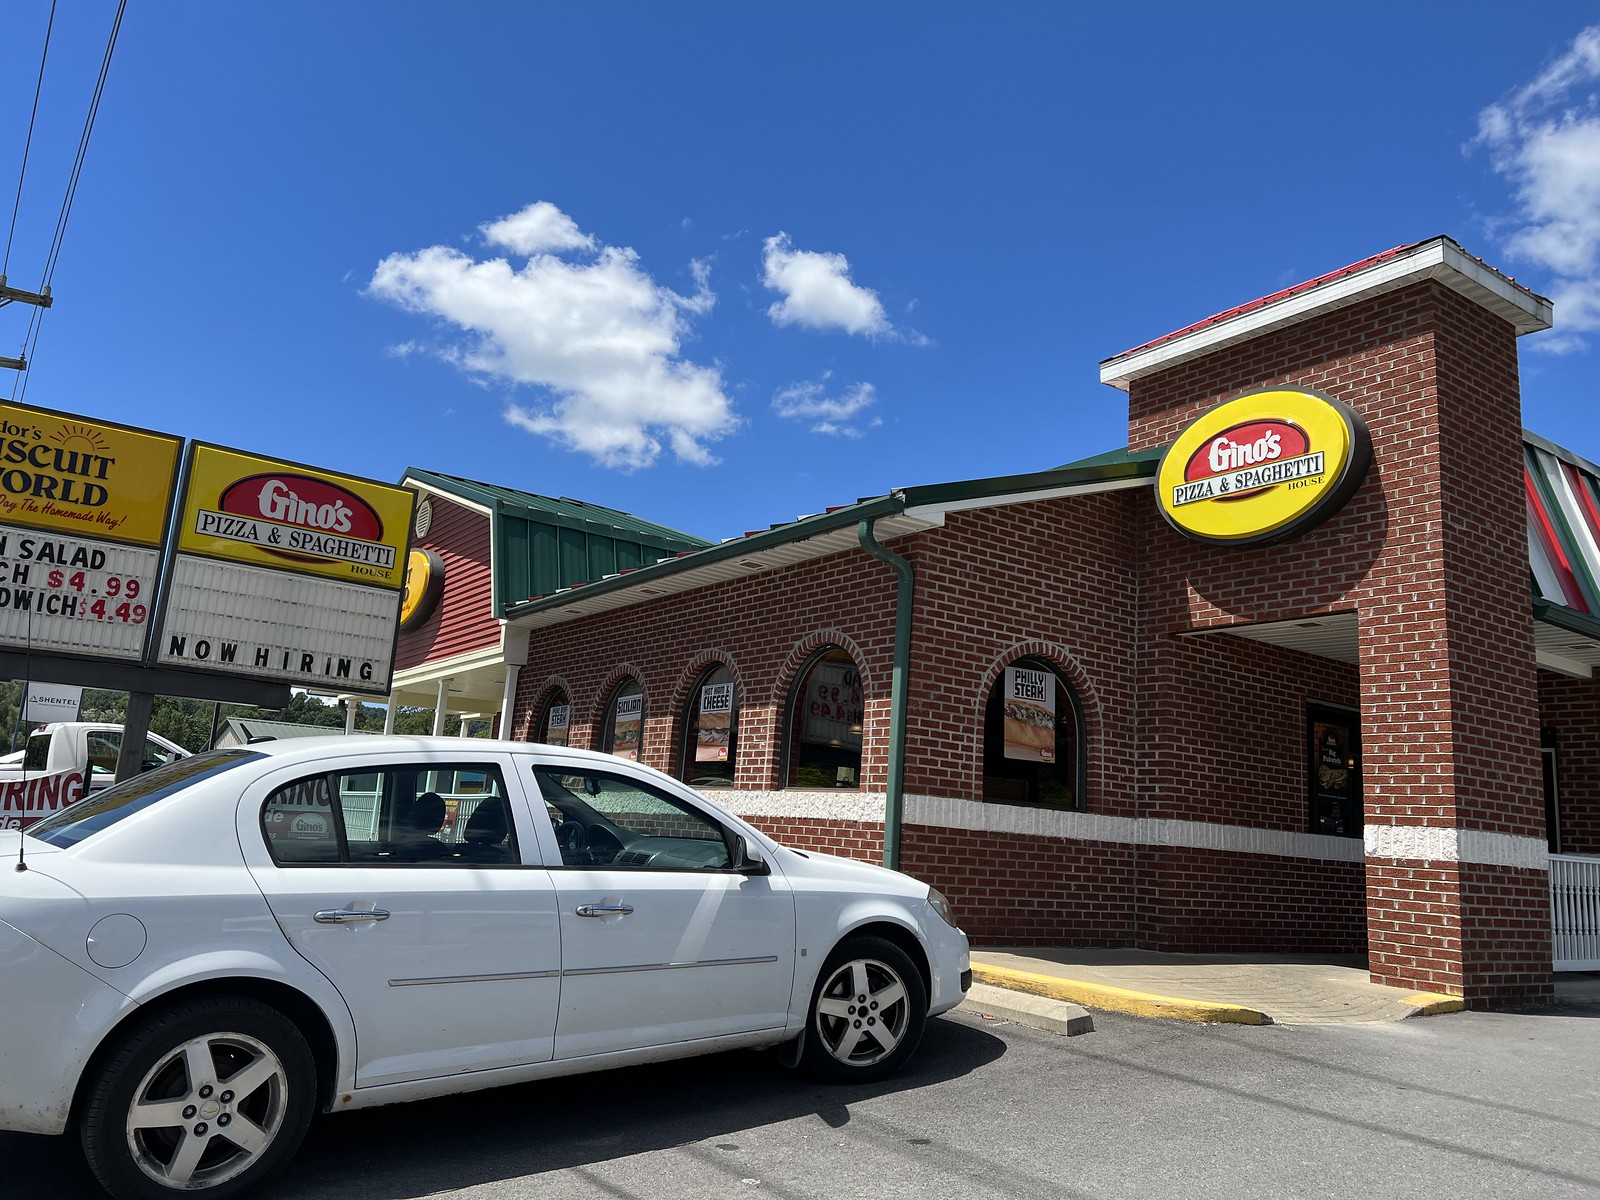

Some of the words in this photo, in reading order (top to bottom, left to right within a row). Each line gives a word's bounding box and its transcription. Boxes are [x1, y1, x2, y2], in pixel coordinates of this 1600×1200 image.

[1208, 430, 1281, 472] Gino's
[0, 466, 108, 507] ORLD
[1175, 481, 1214, 504] PIZZA
[1219, 477, 1230, 491] &
[1235, 455, 1322, 490] SPAGHETTI
[1288, 476, 1325, 491] HOUSE
[21, 499, 38, 512] The
[41, 501, 94, 522] Homemade
[96, 510, 127, 530] Way!
[257, 480, 353, 533] Gino's
[19, 539, 106, 570] SALAD
[200, 514, 260, 541] PIZZA
[268, 527, 281, 544] &
[288, 530, 391, 566] SPAGHETTI
[48, 569, 140, 599] $4.99
[351, 564, 392, 580] HOUSE
[169, 635, 238, 662] NOW
[254, 647, 372, 681] HIRING
[1014, 669, 1045, 685] PHILLY
[1014, 683, 1044, 699] STEAK
[39, 696, 77, 706] SHENTEL
[703, 695, 729, 710] CHEESE
[296, 819, 323, 832] Gino's
